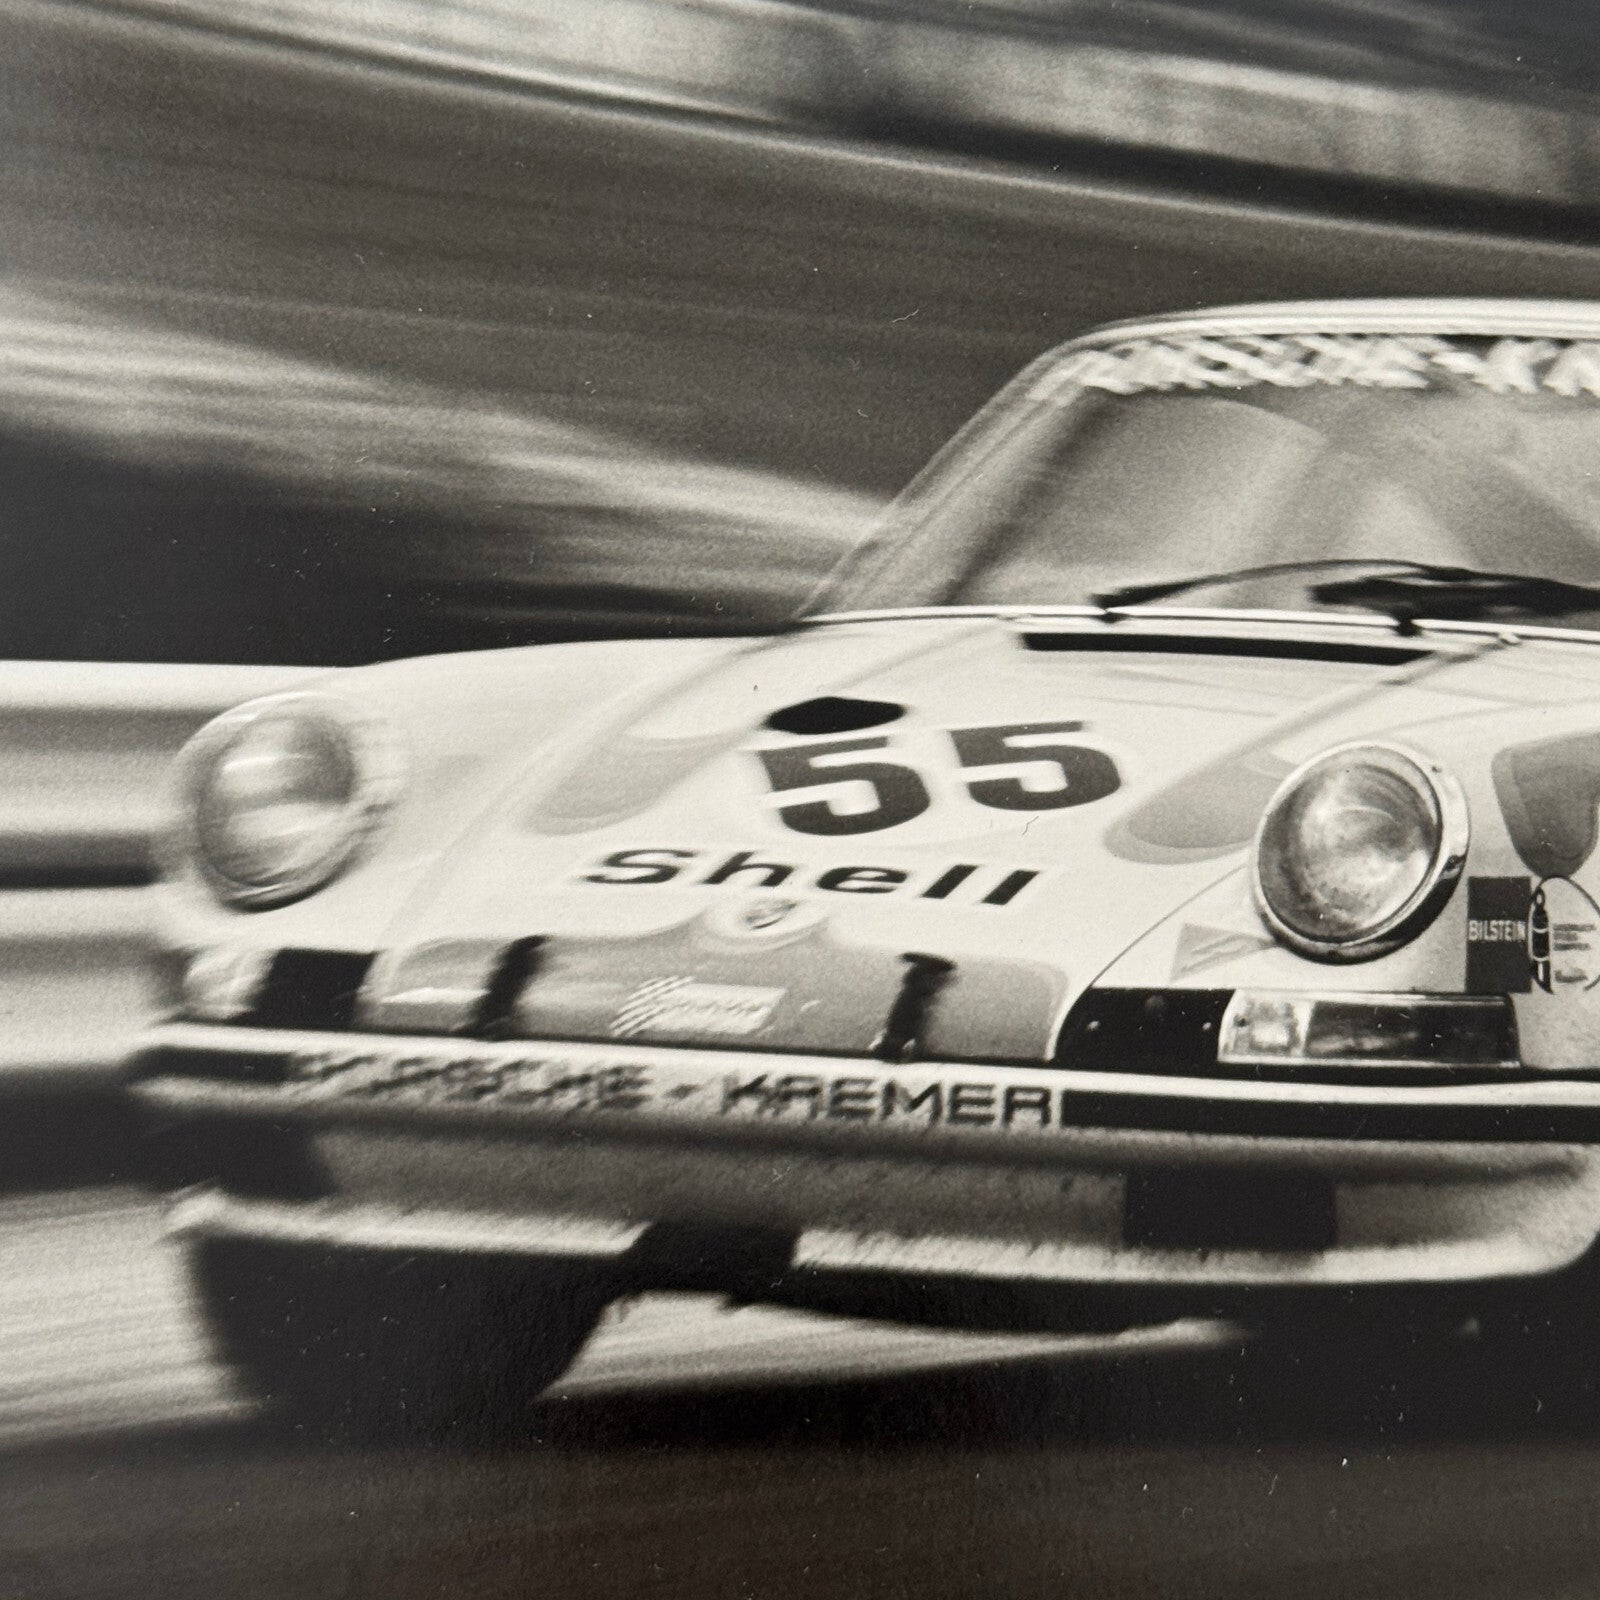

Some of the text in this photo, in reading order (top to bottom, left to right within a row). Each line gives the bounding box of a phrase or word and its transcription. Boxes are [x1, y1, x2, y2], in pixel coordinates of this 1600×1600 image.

[757, 720, 1122, 837] 55
[583, 848, 1041, 906] Shell
[1467, 919, 1527, 942] BILSTEIN
[718, 1070, 1053, 1125] KREMER
